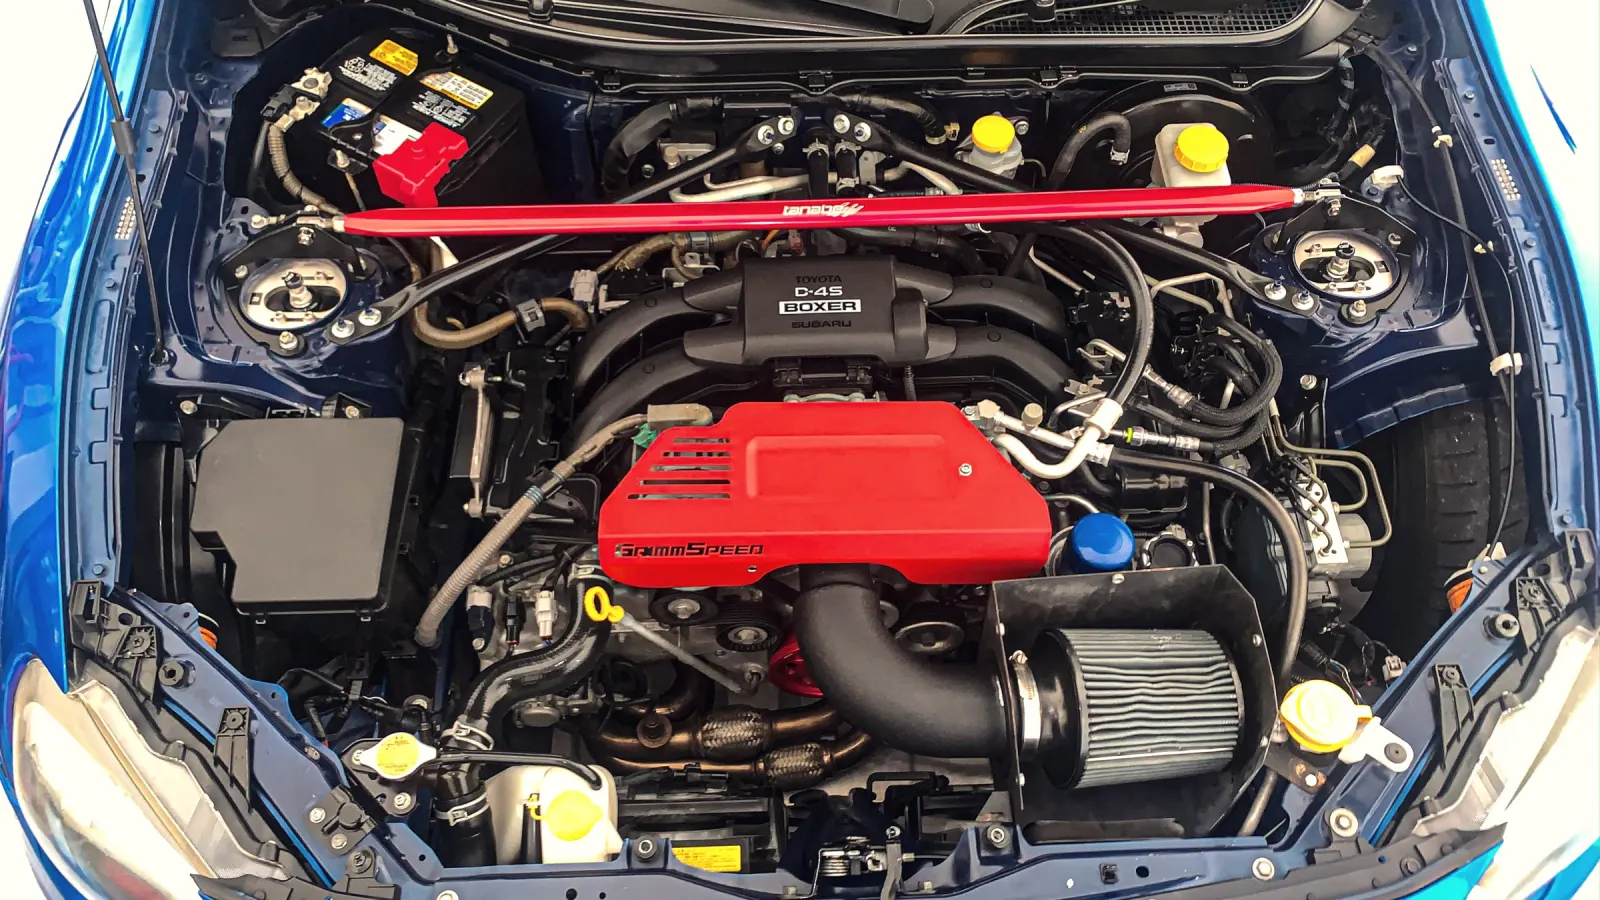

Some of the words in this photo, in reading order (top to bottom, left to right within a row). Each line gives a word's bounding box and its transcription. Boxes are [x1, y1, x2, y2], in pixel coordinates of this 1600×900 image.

[796, 275, 842, 284] TOYOTA
[795, 286, 843, 297] D-4S
[784, 302, 857, 312] BOXER
[791, 321, 852, 329] SUBARU
